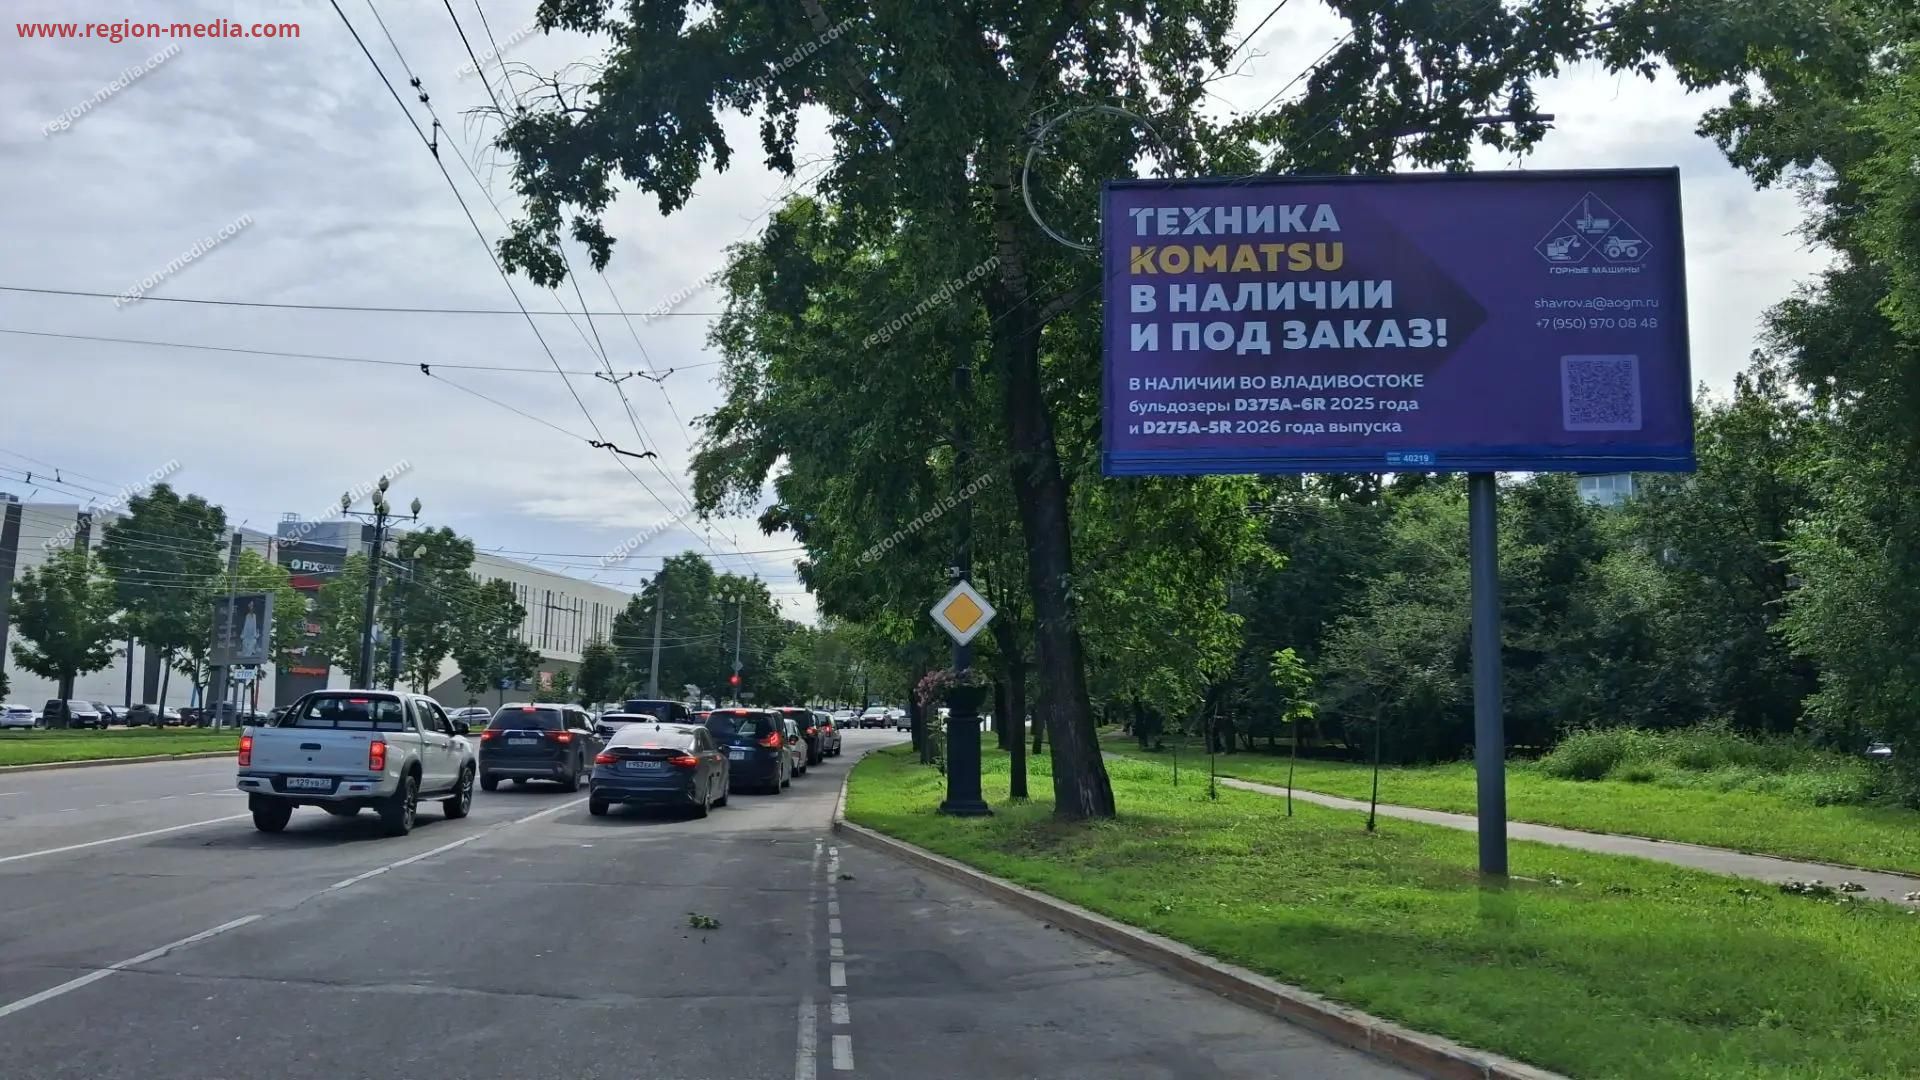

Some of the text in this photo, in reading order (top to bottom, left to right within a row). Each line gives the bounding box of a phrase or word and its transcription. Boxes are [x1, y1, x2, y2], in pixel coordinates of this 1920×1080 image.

[1129, 204, 1341, 236] ТЕХНИКА
[1130, 242, 1344, 275] KOMATSU
[1131, 279, 1393, 313] В НАЛИЧИИ
[1534, 297, 1659, 311] shavrov.a@aogm.ru
[1536, 317, 1658, 330] +7 (950) 970 08 48
[1131, 318, 1448, 355] И ПОД ЗАКАЗ!
[1129, 374, 1424, 391] В НАЛИЧИИ ВО ВЛАДИВОСТОКЕ
[1129, 397, 1420, 415] бульдозеры D375A-6R 2025 года
[1129, 420, 1402, 436] и D275A-5R 2026 года выпуска
[1403, 454, 1429, 462] 40219
